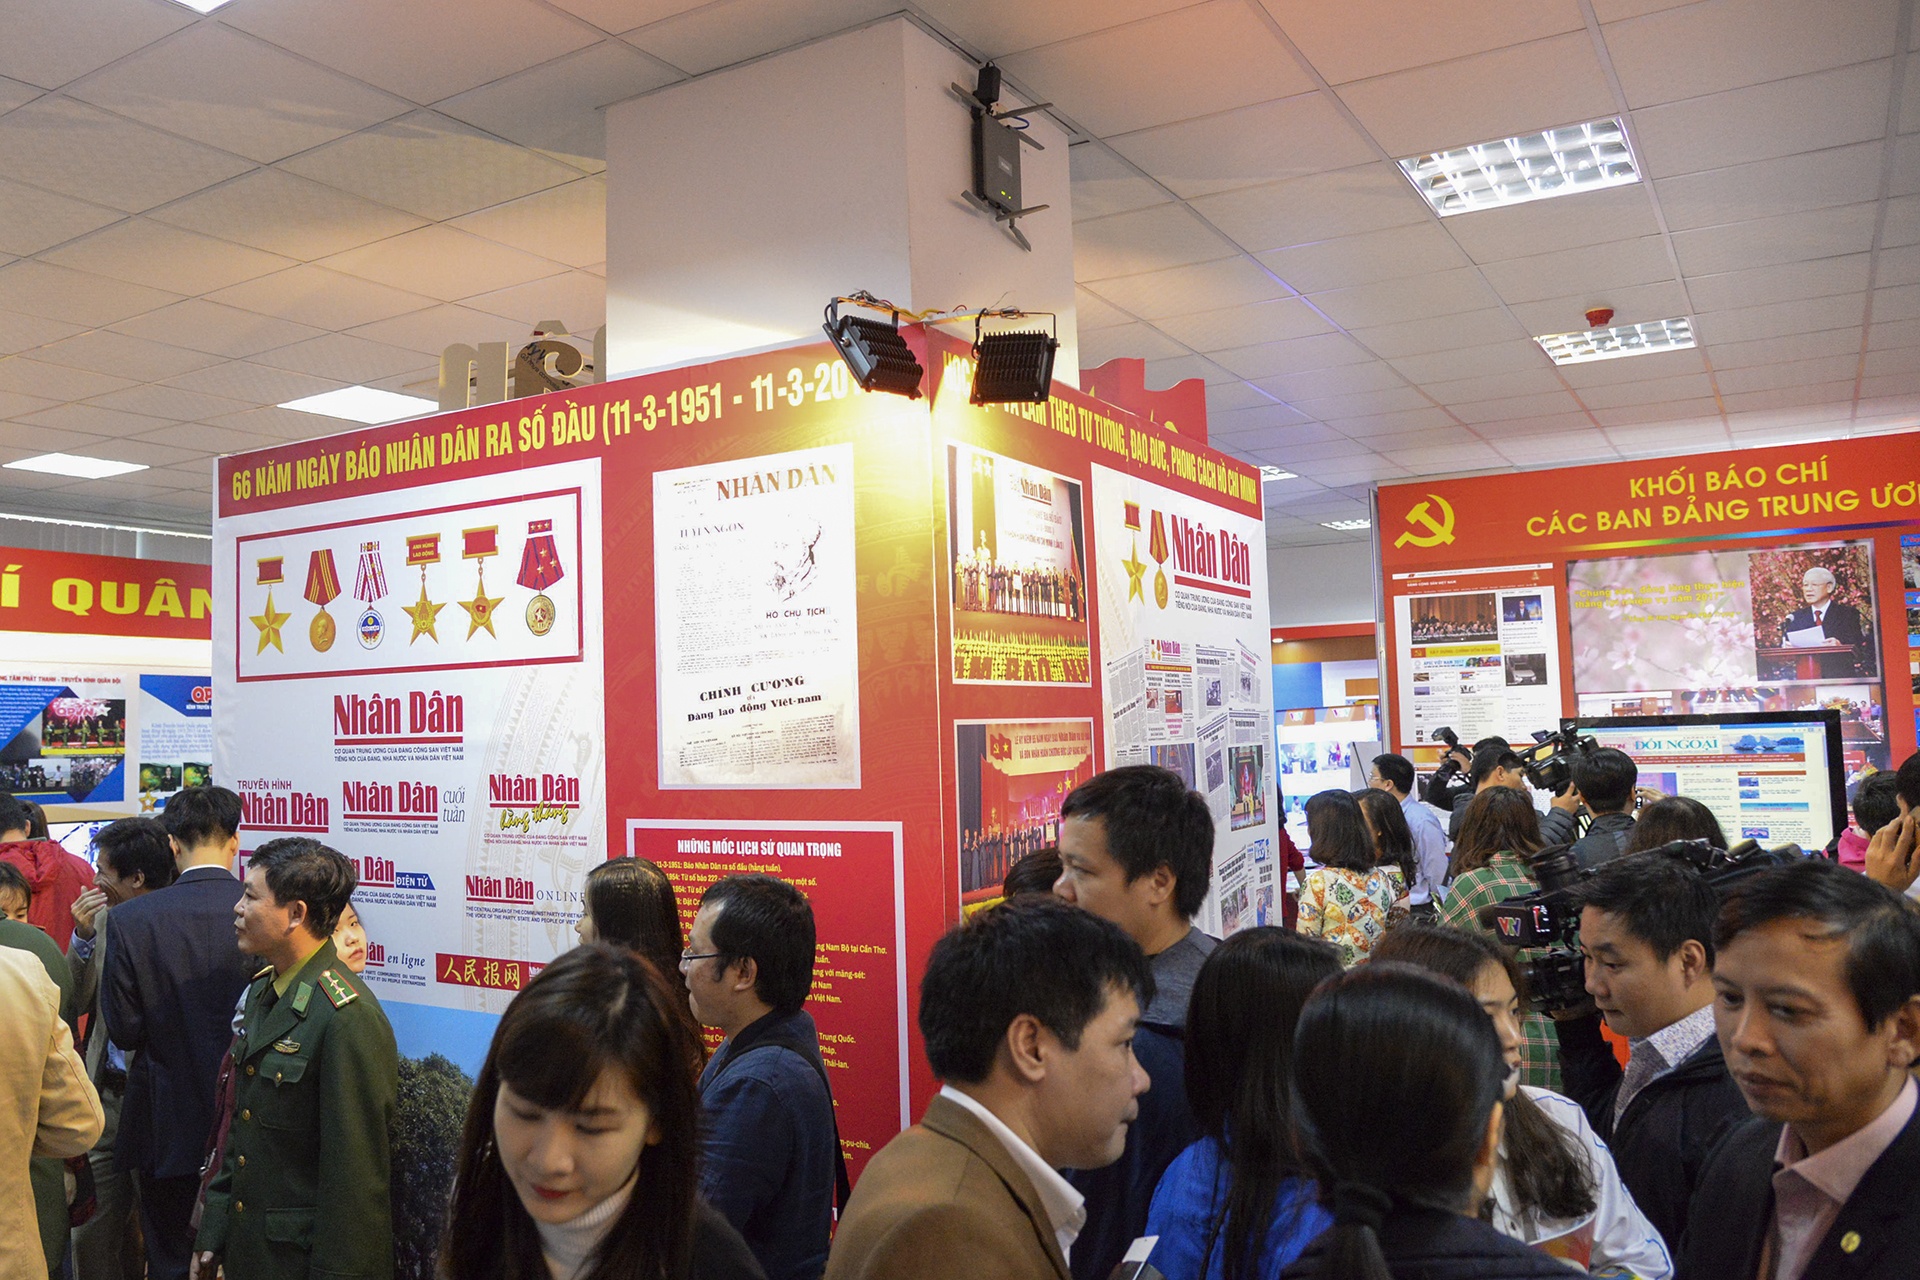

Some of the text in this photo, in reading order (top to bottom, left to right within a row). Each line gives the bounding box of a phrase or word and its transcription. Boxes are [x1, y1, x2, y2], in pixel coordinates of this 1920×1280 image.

[232, 470, 251, 501] 66
[255, 459, 292, 497] NĂM
[296, 449, 341, 490] NGÀY
[345, 441, 381, 482] BÁO
[386, 432, 435, 475] NHÂN
[441, 424, 480, 465] DÂN
[486, 421, 513, 458] RA
[518, 403, 546, 453] SỐ
[551, 399, 596, 446] ĐẦU
[602, 382, 722, 446] (11-3-1951
[733, 394, 743, 405] -
[1048, 394, 1077, 438] THEO
[1078, 406, 1094, 443] TƯ
[1094, 409, 1129, 462] TƯỞNG,
[1130, 428, 1149, 469] ĐẠO
[1150, 434, 1170, 478] ĐỨC,
[1170, 445, 1197, 483] PHONG
[1197, 453, 1217, 491] CÁCH
[1217, 457, 1227, 495] HỒ
[1227, 466, 1239, 498] CHÍ
[1239, 473, 1257, 505] MINH
[1629, 455, 1828, 499] KHỐI BÁO CHÍ
[1526, 480, 1920, 537] CÁC BAN ĐẢNG TRUNG ƯƠ
[1171, 513, 1251, 587] Nhân Dân
[333, 690, 464, 736] Nhân Dân
[718, 707, 735, 717] lao
[740, 702, 767, 713] động
[1667, 738, 1719, 752] NGOẠI
[271, 778, 292, 790] HÌNH
[489, 774, 580, 802] Nhân Dân
[343, 781, 438, 813] Nhân Dân
[443, 786, 466, 804] cuối
[240, 791, 329, 826] Nhân Dân
[443, 804, 466, 823] tuần
[677, 837, 842, 859] NHỮNG MỐC LỊCH SỬ QUAN TRỌNG
[364, 855, 395, 882] Dân
[683, 861, 694, 870] Báo
[728, 862, 736, 871] số
[396, 874, 428, 888] ĐIỆN TỬ
[689, 872, 697, 881] số
[465, 875, 502, 898] Nhân
[505, 877, 534, 900] Dân
[825, 943, 840, 952] Nam
[840, 943, 850, 953] Bộ
[387, 954, 399, 964] en
[401, 953, 426, 970] ligne
[443, 957, 520, 990] 人民报网
[818, 981, 832, 990] Nam
[819, 1032, 856, 1043] Trung Quốc.
[819, 1045, 837, 1055] Pháp.
